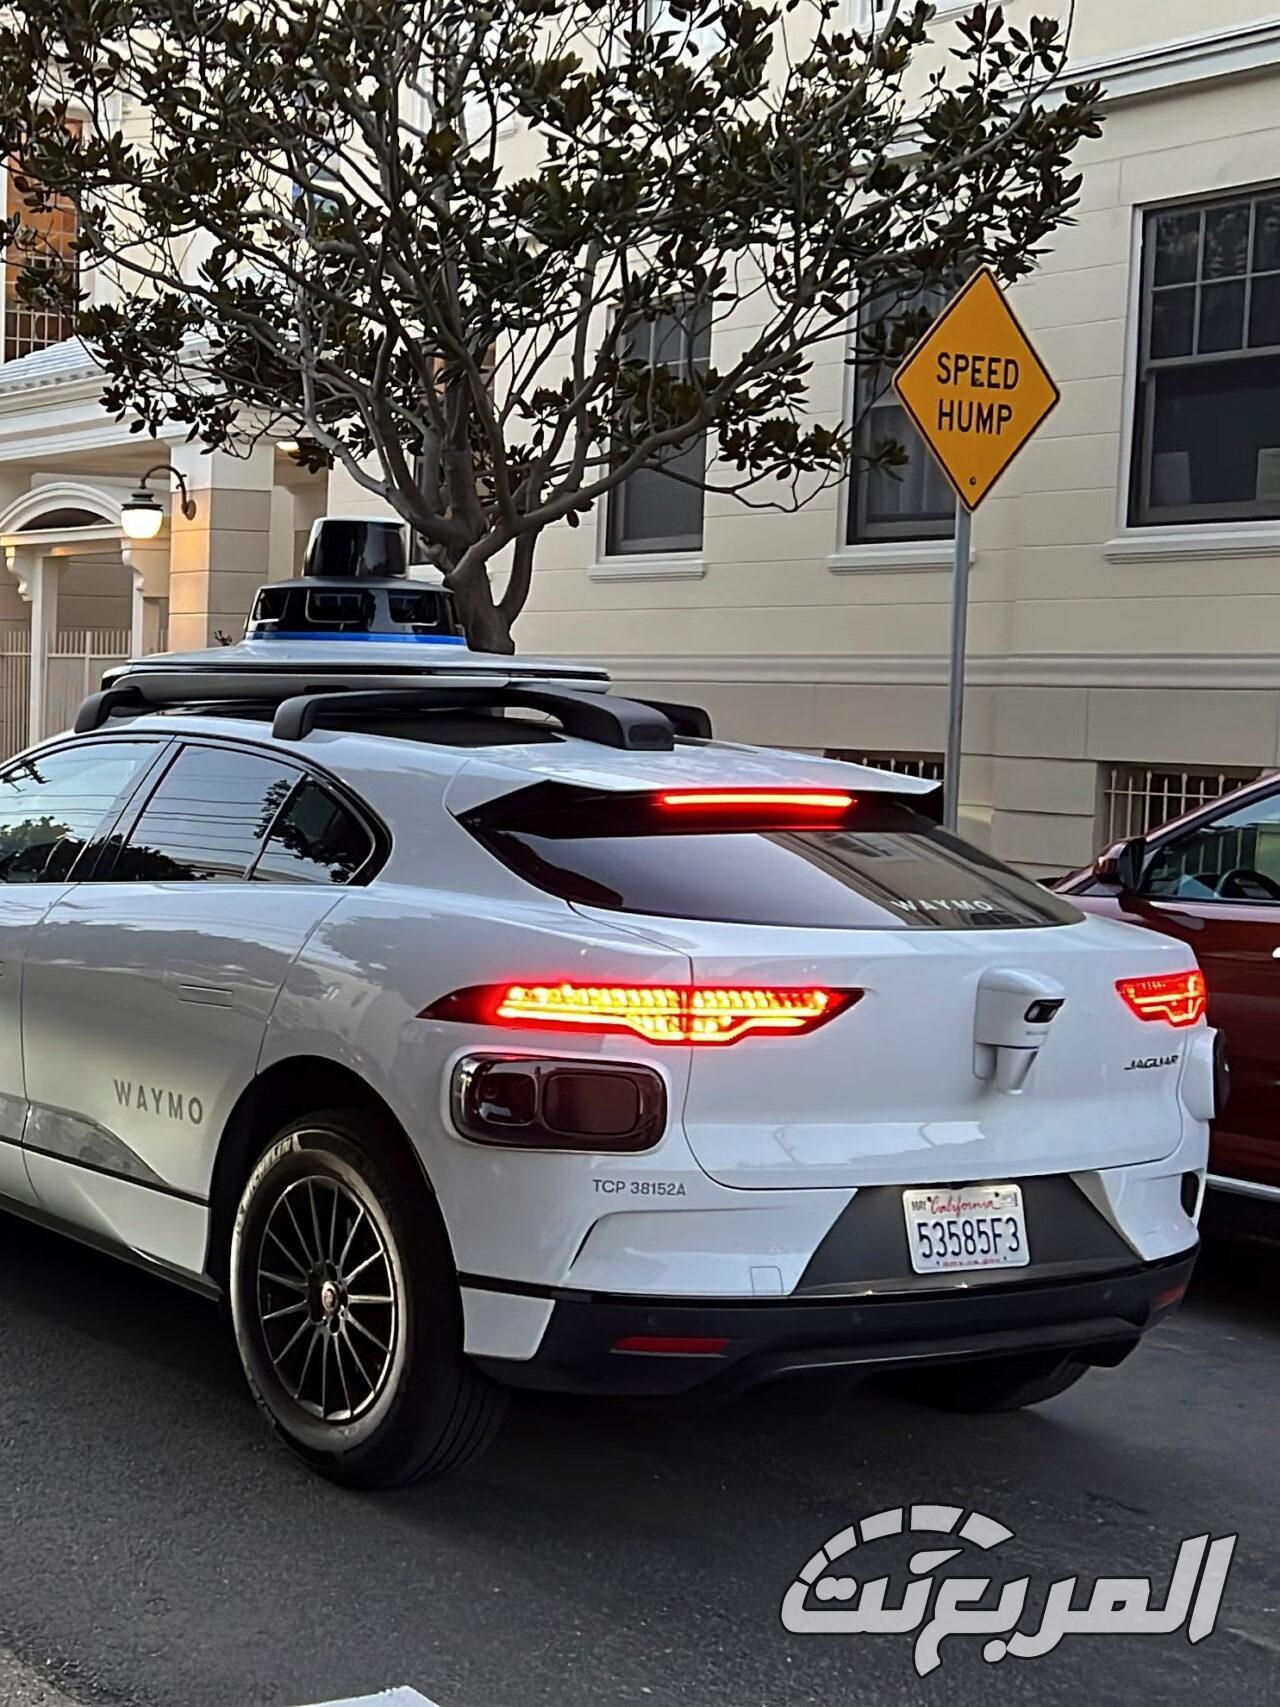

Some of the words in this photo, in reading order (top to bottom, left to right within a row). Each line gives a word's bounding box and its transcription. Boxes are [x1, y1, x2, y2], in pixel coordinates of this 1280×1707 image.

[936, 352, 1019, 390] SPEED
[937, 399, 1013, 435] HUMP
[890, 899, 994, 912] WAYMO
[1123, 1054, 1179, 1070] JAGUAR
[113, 1078, 203, 1125] WAYMO
[592, 1179, 626, 1193] TCP
[630, 1181, 686, 1196] 38152A
[929, 1195, 1001, 1217] California
[916, 1217, 1020, 1258] 53585F3
